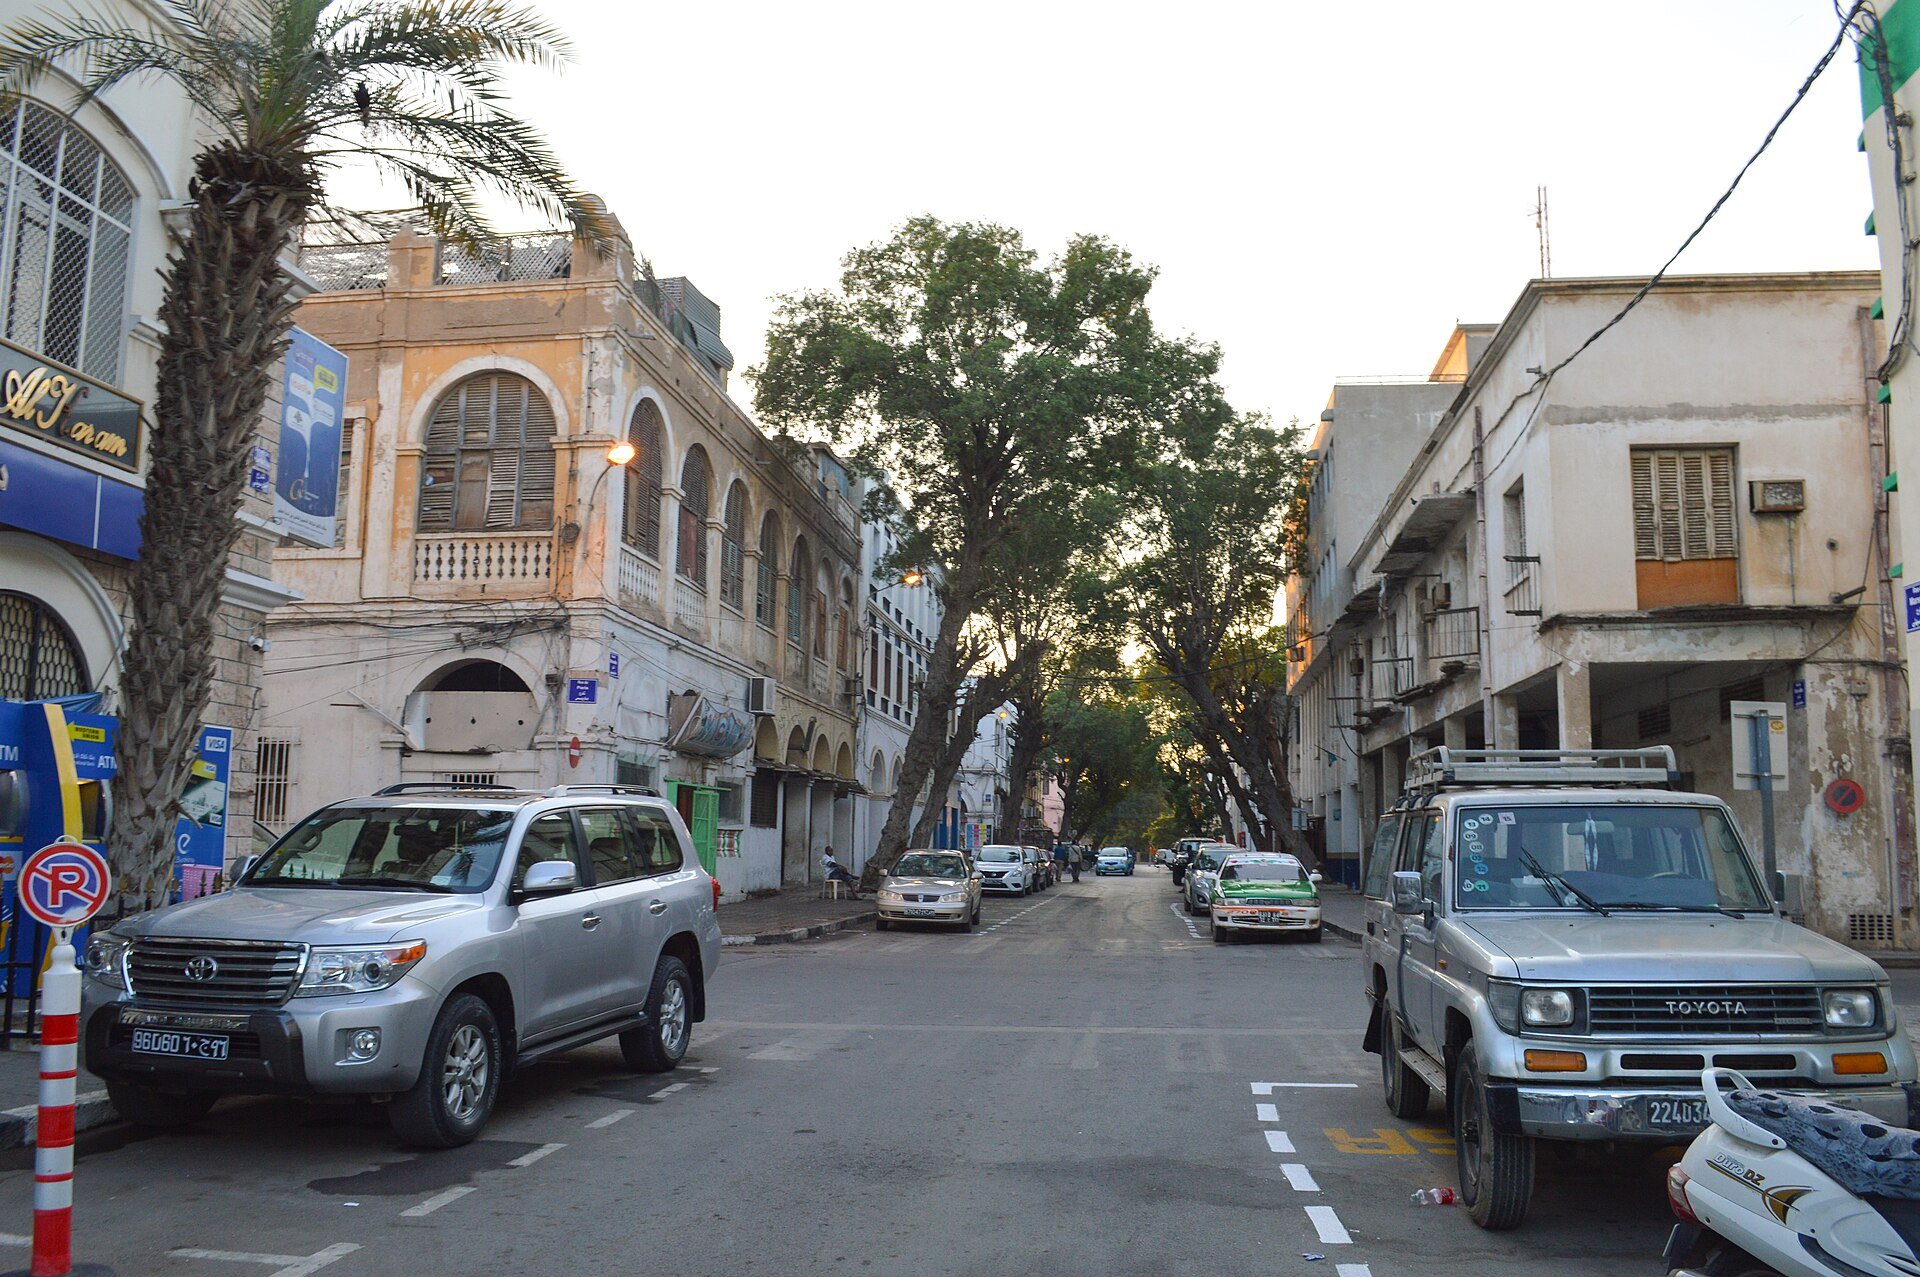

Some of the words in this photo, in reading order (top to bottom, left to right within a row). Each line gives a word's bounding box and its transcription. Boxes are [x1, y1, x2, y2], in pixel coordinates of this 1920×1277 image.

[208, 739, 226, 750] VISA
[1665, 1001, 1748, 1015] TOYOTA
[134, 1031, 181, 1053] 96D60
[1714, 1152, 1744, 1175] Duro
[1742, 1168, 1766, 1186] DZ
